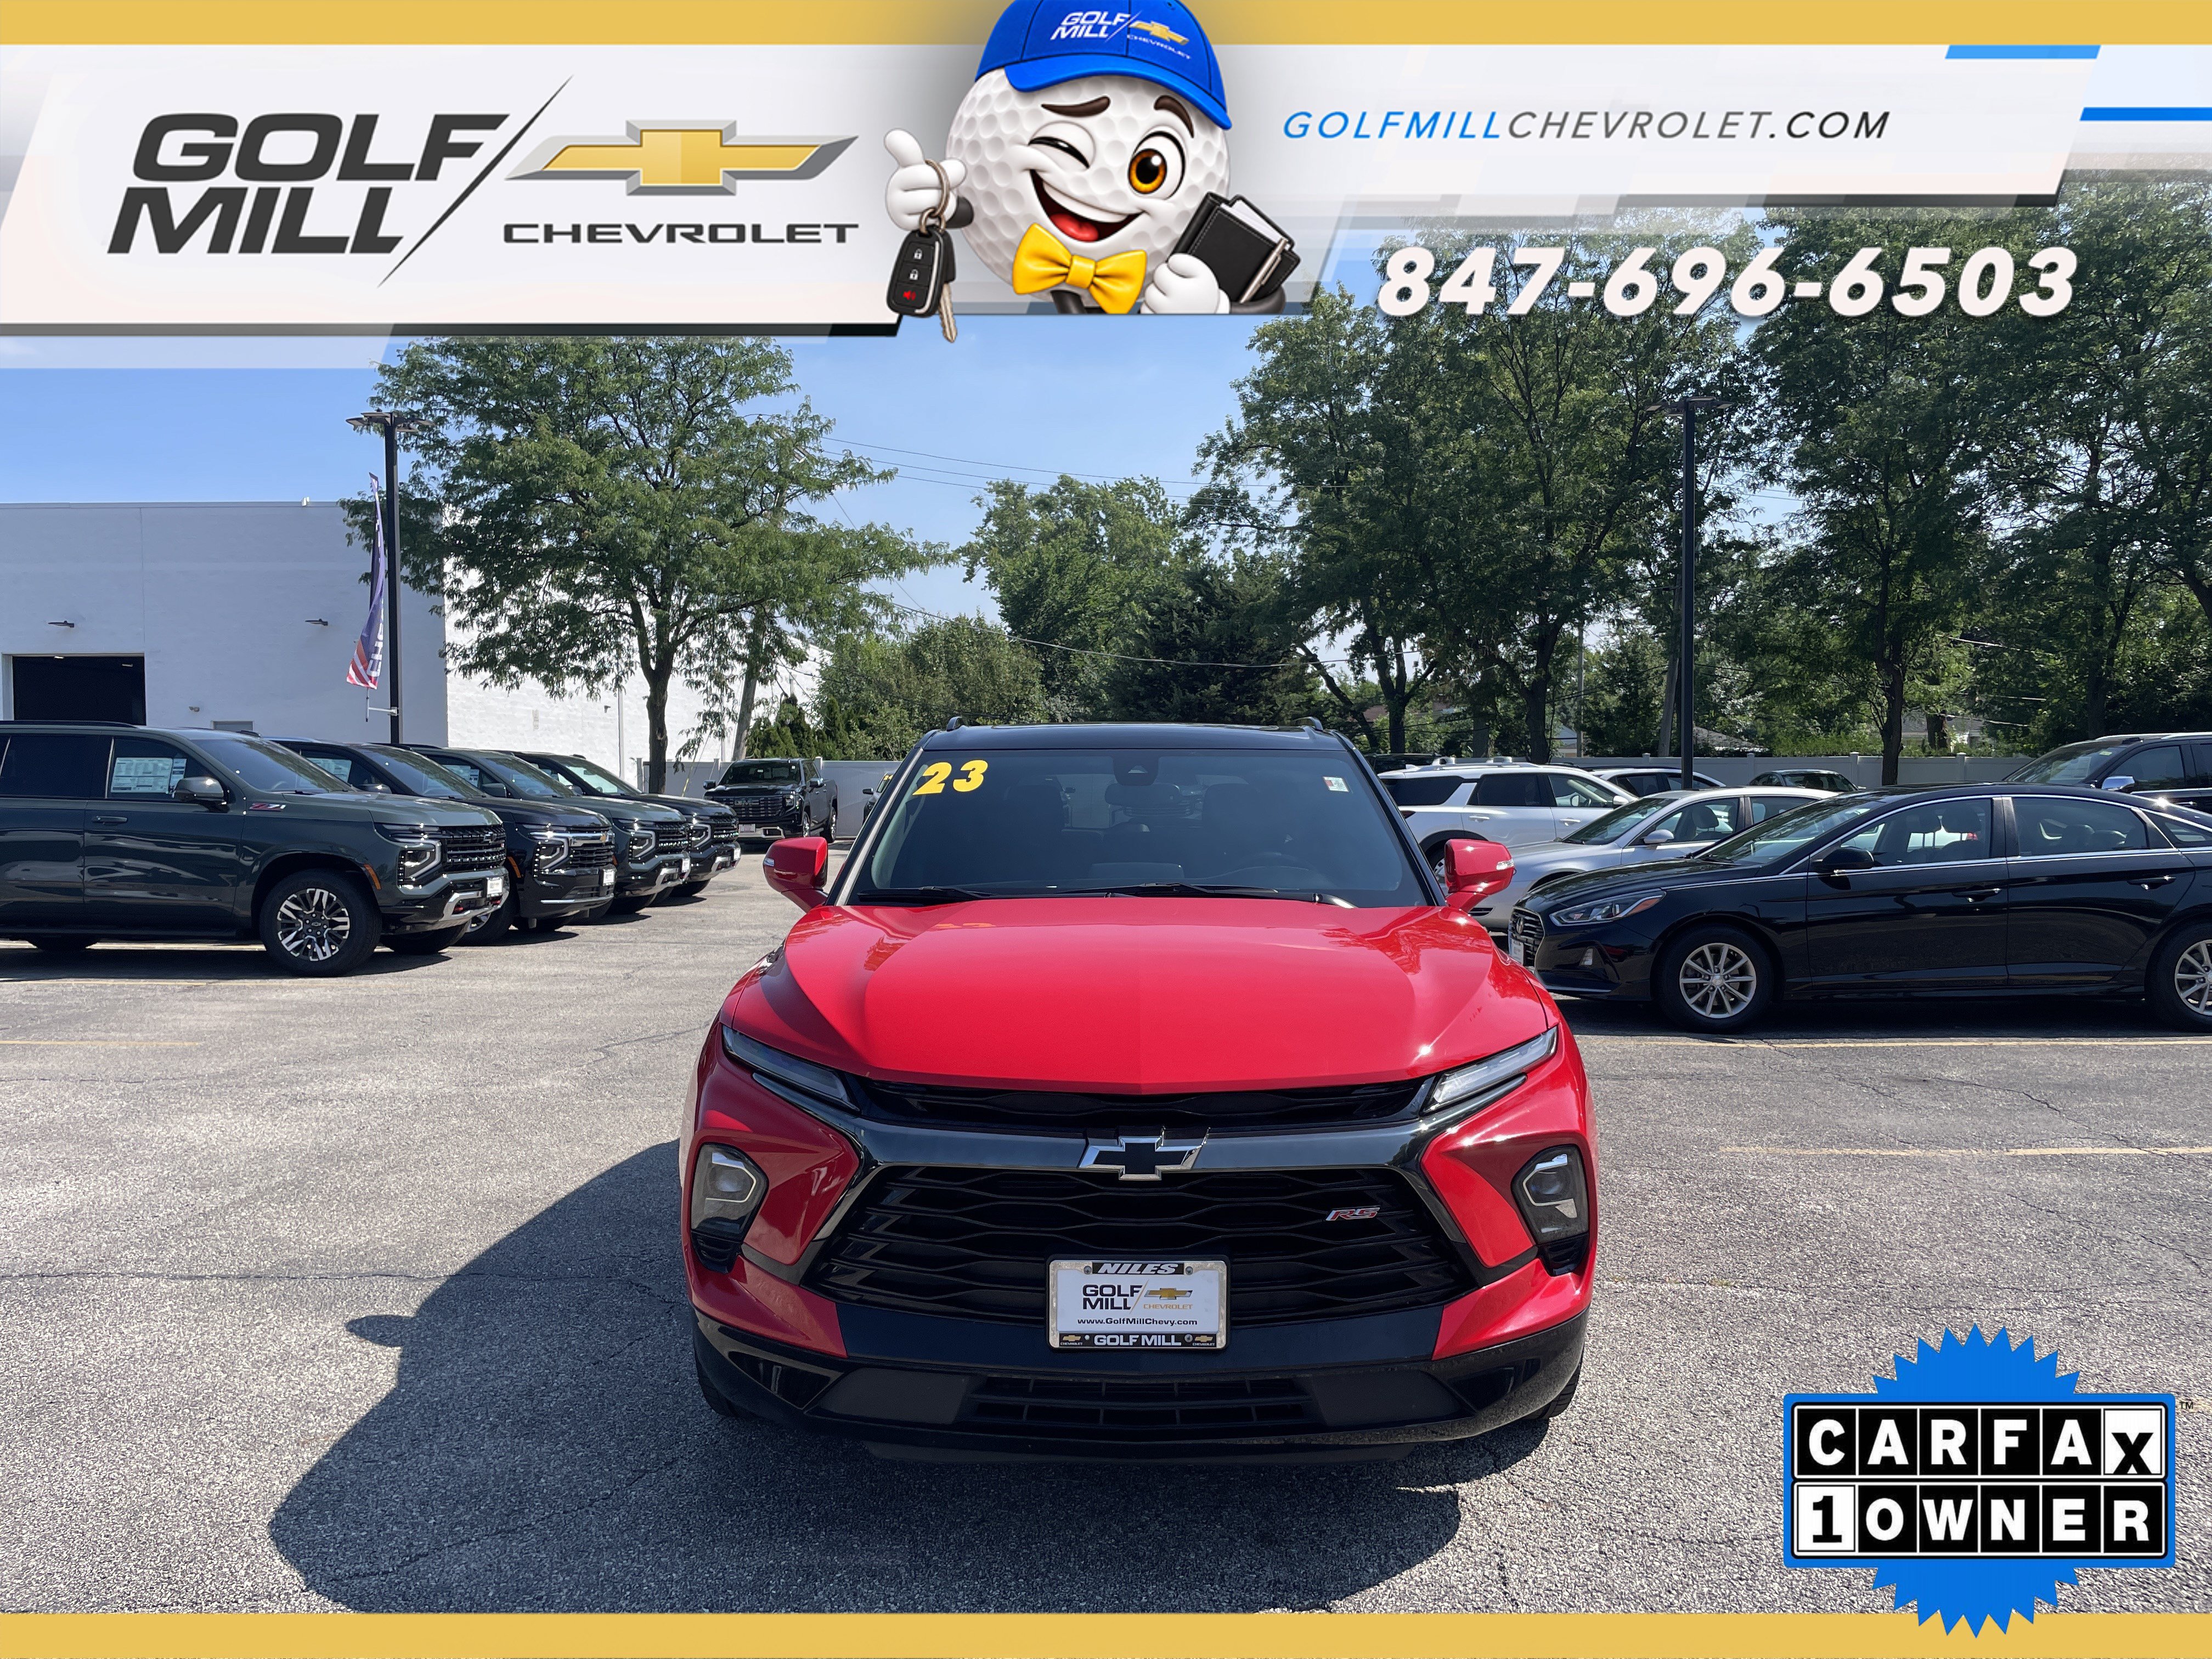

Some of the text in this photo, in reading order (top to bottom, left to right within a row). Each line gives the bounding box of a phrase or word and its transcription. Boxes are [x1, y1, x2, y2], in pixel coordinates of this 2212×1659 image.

[912, 759, 988, 795] 23
[1325, 1207, 1380, 1221] RS
[1097, 1263, 1179, 1274] NILES
[1082, 1284, 1143, 1297] GOLF
[1082, 1297, 1132, 1310] MILL
[1077, 1317, 1198, 1326] www.GolfMillChevy.com
[1094, 1334, 1182, 1346] GOLF MILL
